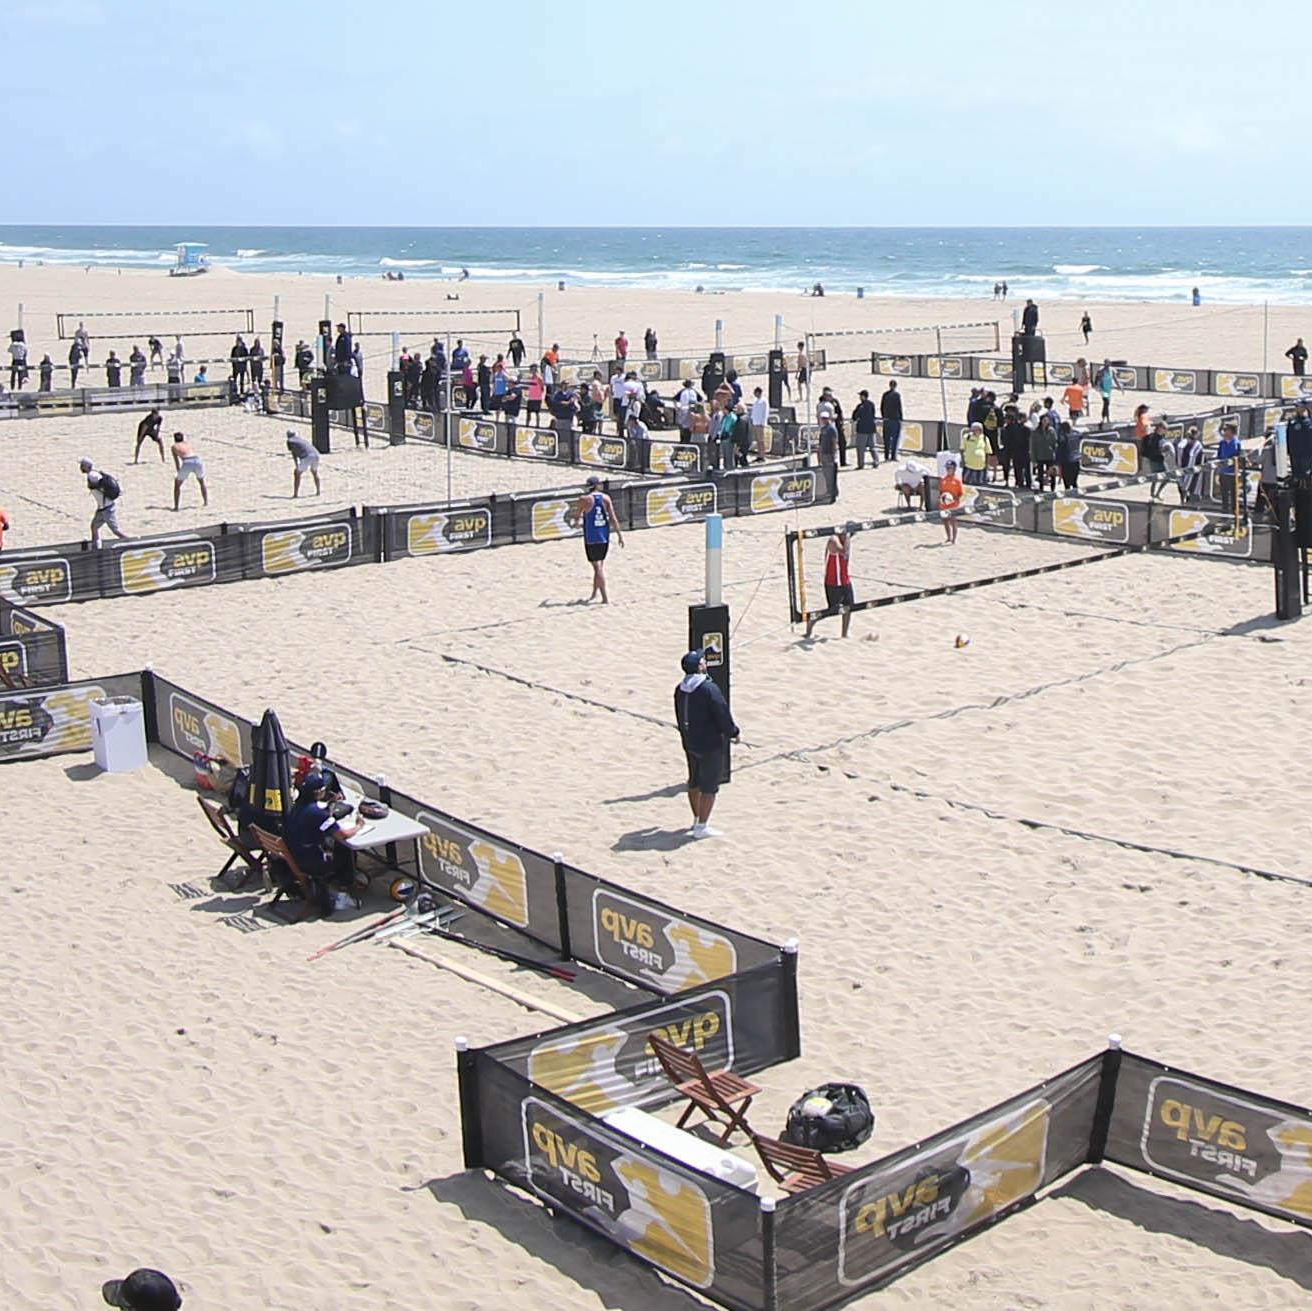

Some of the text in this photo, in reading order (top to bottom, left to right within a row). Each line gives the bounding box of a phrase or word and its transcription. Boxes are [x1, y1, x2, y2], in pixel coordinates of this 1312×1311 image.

[685, 491, 713, 506] avp
[454, 515, 487, 534] avp
[1093, 508, 1124, 527] avp
[312, 530, 346, 549] avp
[449, 530, 474, 540] FIRST
[172, 550, 210, 568] avp
[25, 567, 65, 586] avp
[167, 566, 196, 577] FIRST
[20, 584, 51, 595] FIRST
